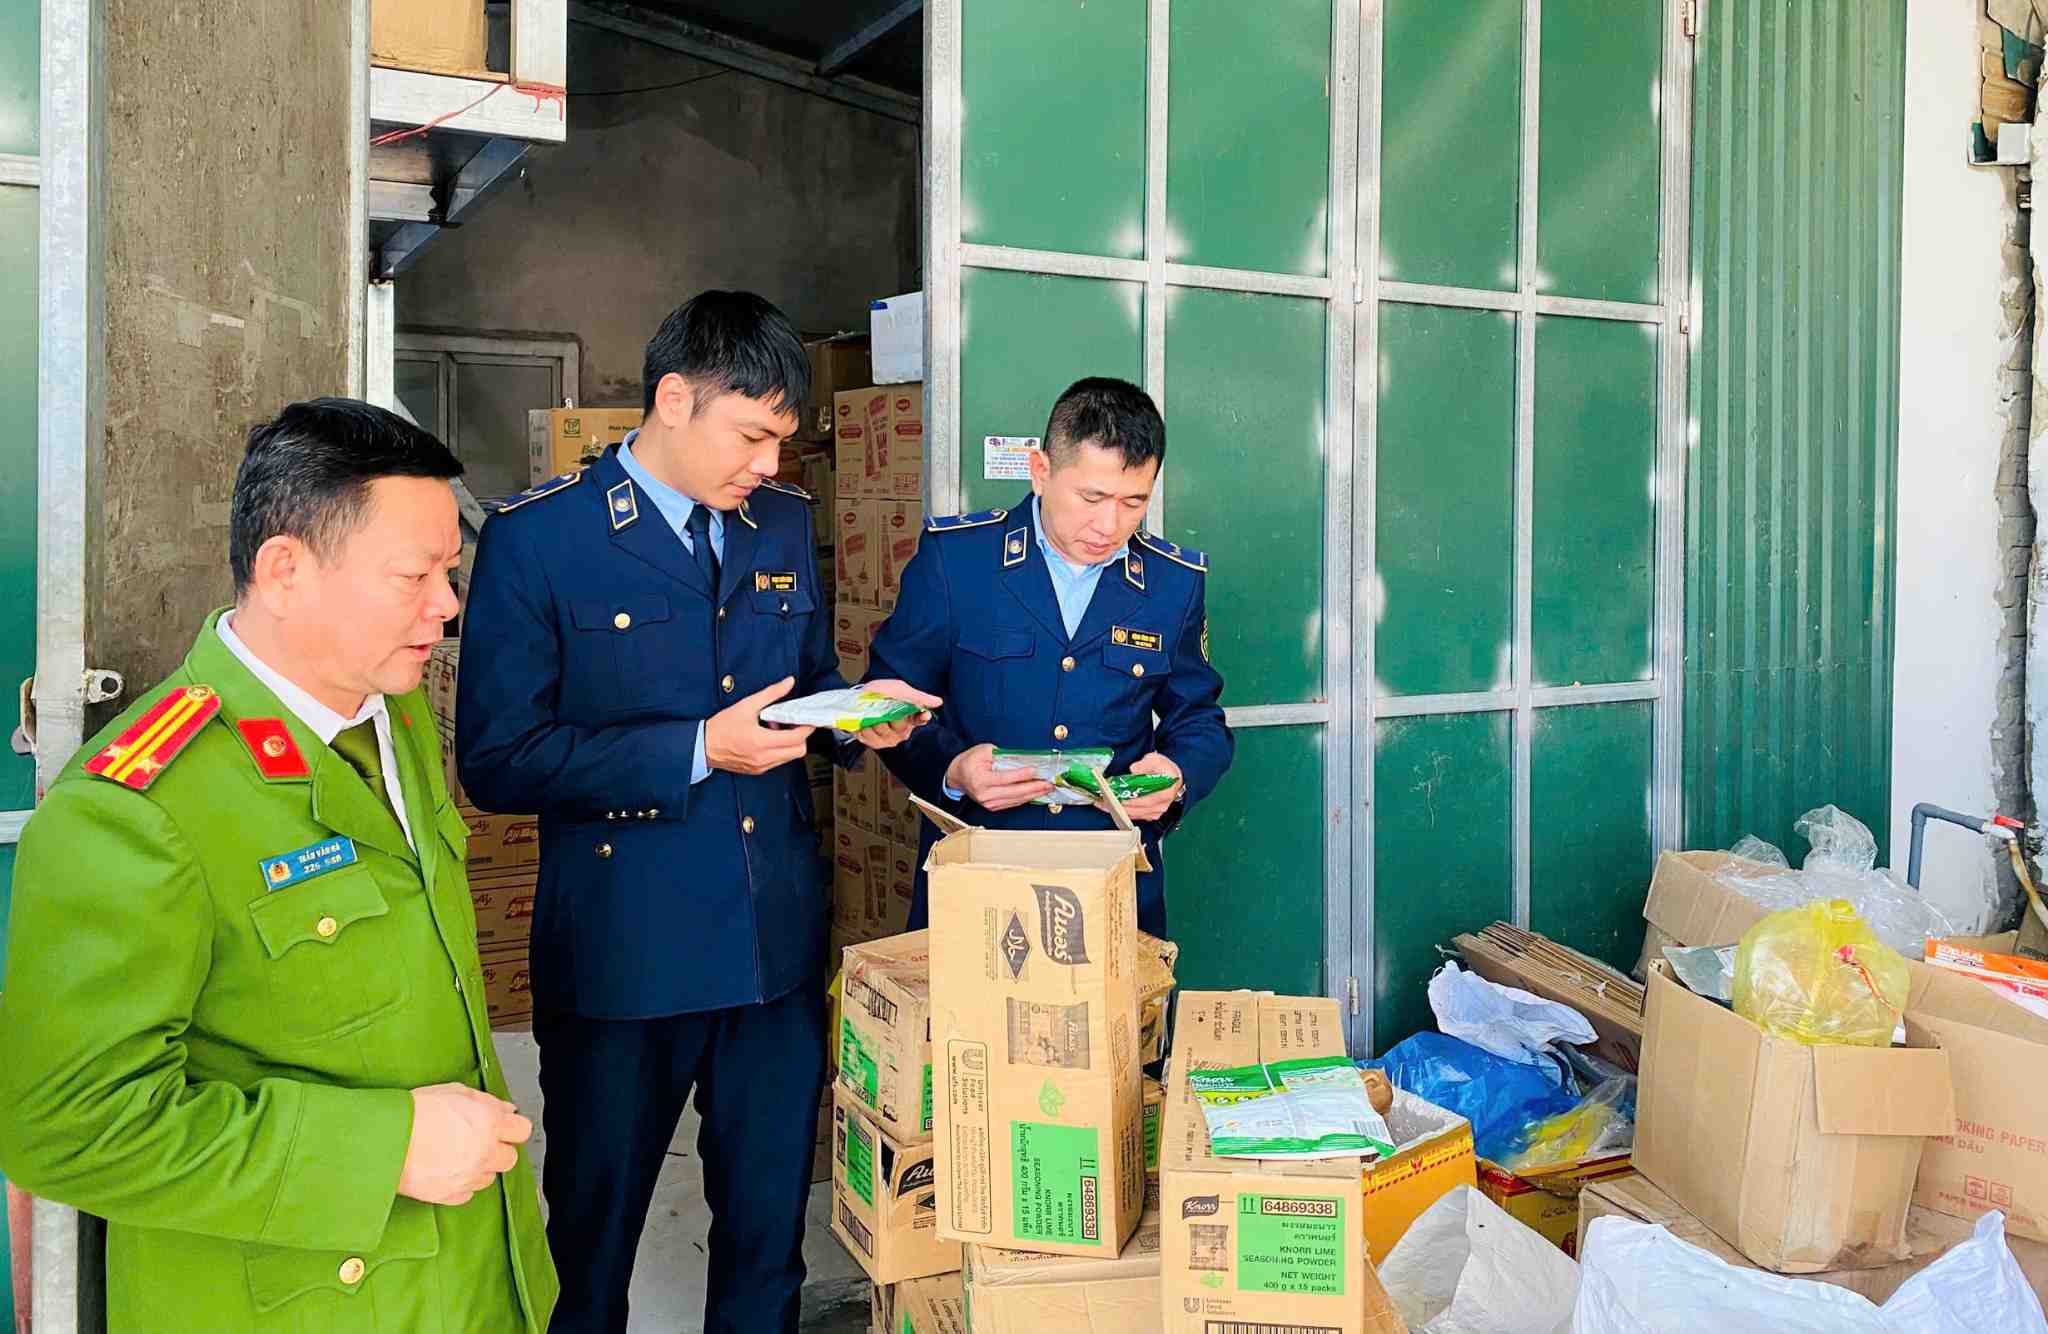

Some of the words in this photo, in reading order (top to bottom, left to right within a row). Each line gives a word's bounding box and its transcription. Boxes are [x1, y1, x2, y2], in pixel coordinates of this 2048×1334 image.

[1083, 1179, 1097, 1237] 64869338
[1263, 1200, 1334, 1215] 64869338
[1279, 1245, 1311, 1255] KNORR
[1314, 1247, 1336, 1256] LIME
[1242, 1255, 1294, 1265] SEASONING
[1297, 1257, 1336, 1266] POWDER
[1281, 1271, 1299, 1280] NET
[1301, 1272, 1337, 1281] WEIGHT
[1263, 1281, 1279, 1290] 400
[1298, 1283, 1309, 1291] 15
[1311, 1283, 1337, 1293] packs
